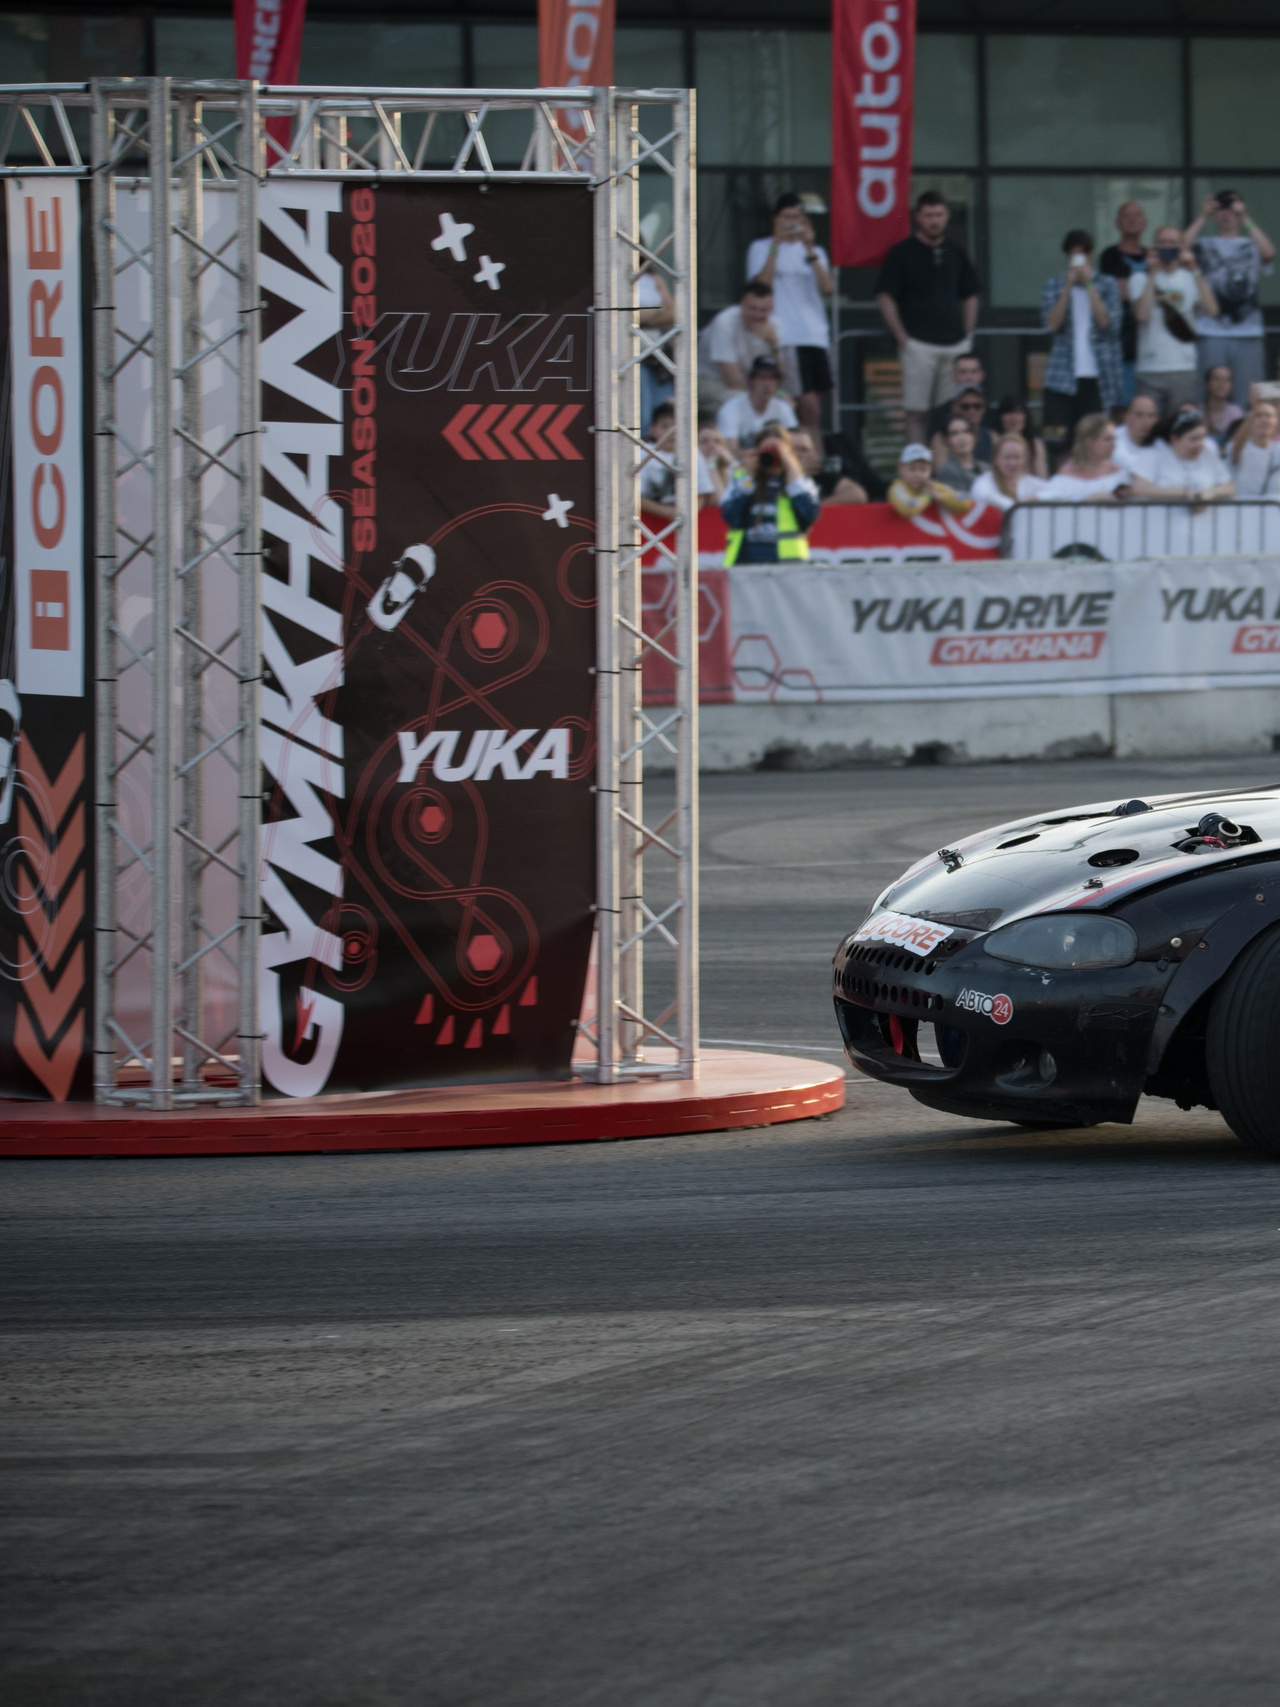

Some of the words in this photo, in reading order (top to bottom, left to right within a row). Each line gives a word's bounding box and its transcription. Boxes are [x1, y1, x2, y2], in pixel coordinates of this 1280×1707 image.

[350, 186, 377, 330] 2026
[350, 338, 377, 554] SEASON
[850, 596, 966, 634] YUKA
[973, 590, 1115, 631] DRIVE
[1159, 588, 1266, 623] YUKA
[258, 180, 345, 1098] GYMKHANA
[935, 634, 1100, 664] GYMKHANA
[396, 727, 571, 783] YUKA
